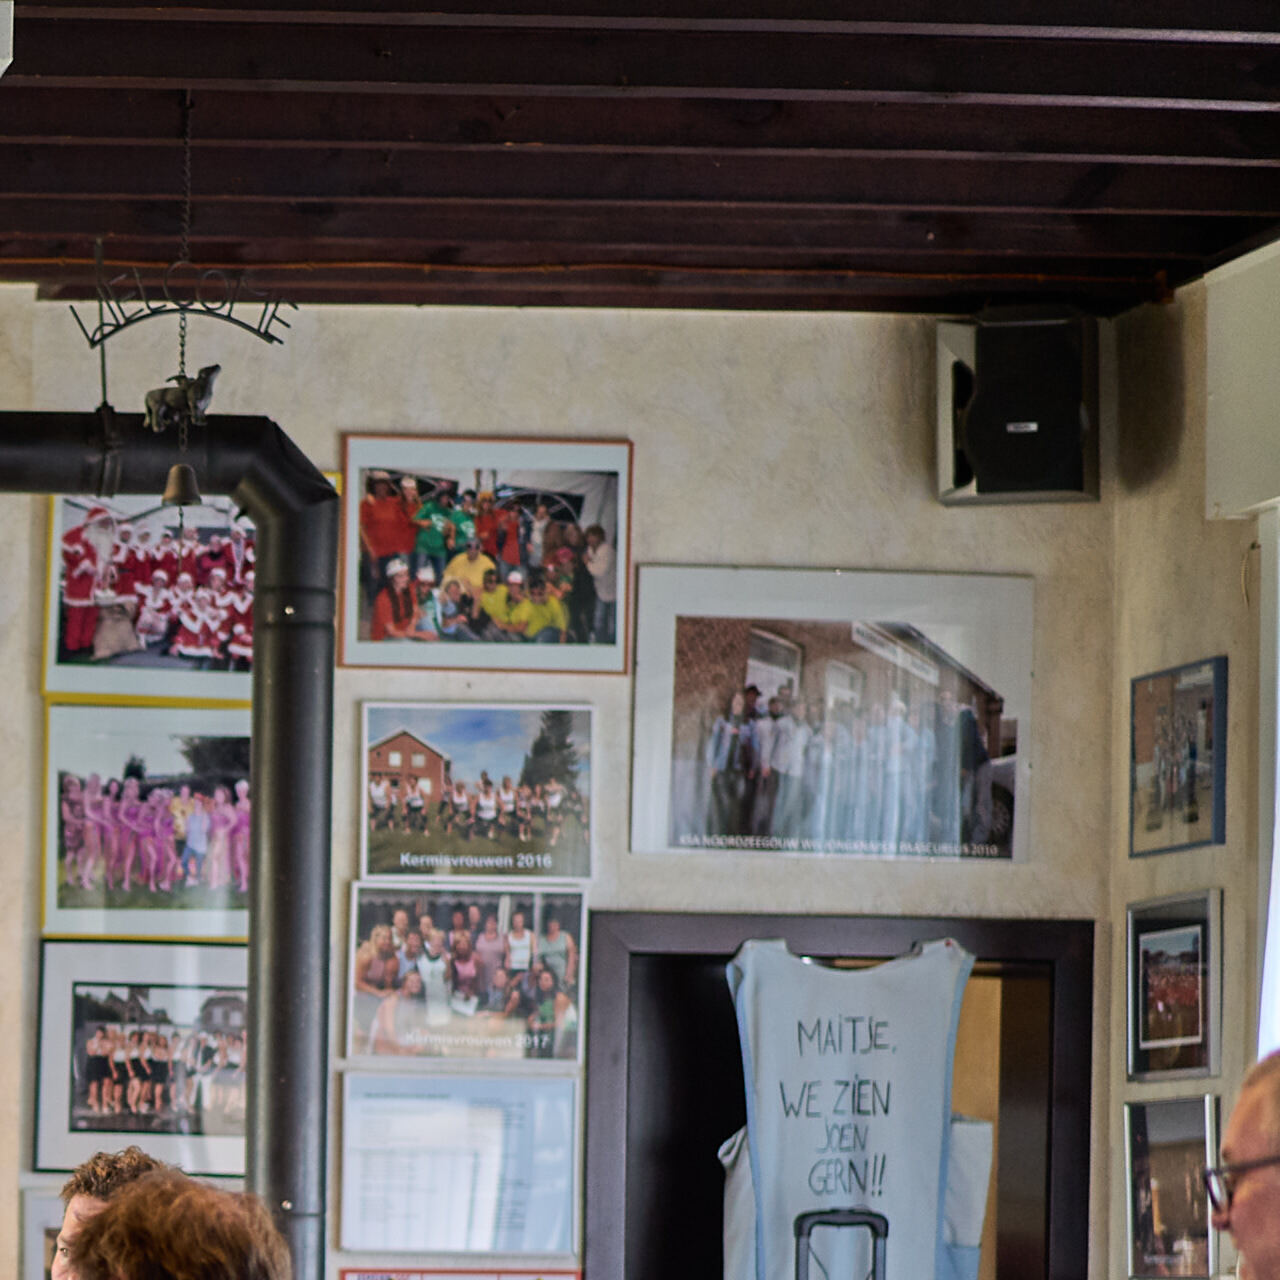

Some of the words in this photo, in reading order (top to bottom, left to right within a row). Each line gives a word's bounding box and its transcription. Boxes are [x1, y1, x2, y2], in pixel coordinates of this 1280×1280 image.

[400, 852, 513, 869] Kermisvrouwen
[516, 852, 553, 869] 2016
[405, 1031, 513, 1048] Kermisvrouwen
[514, 1033, 551, 1049] 2017
[778, 1079, 822, 1119] WE
[832, 1073, 892, 1118] ZIEN
